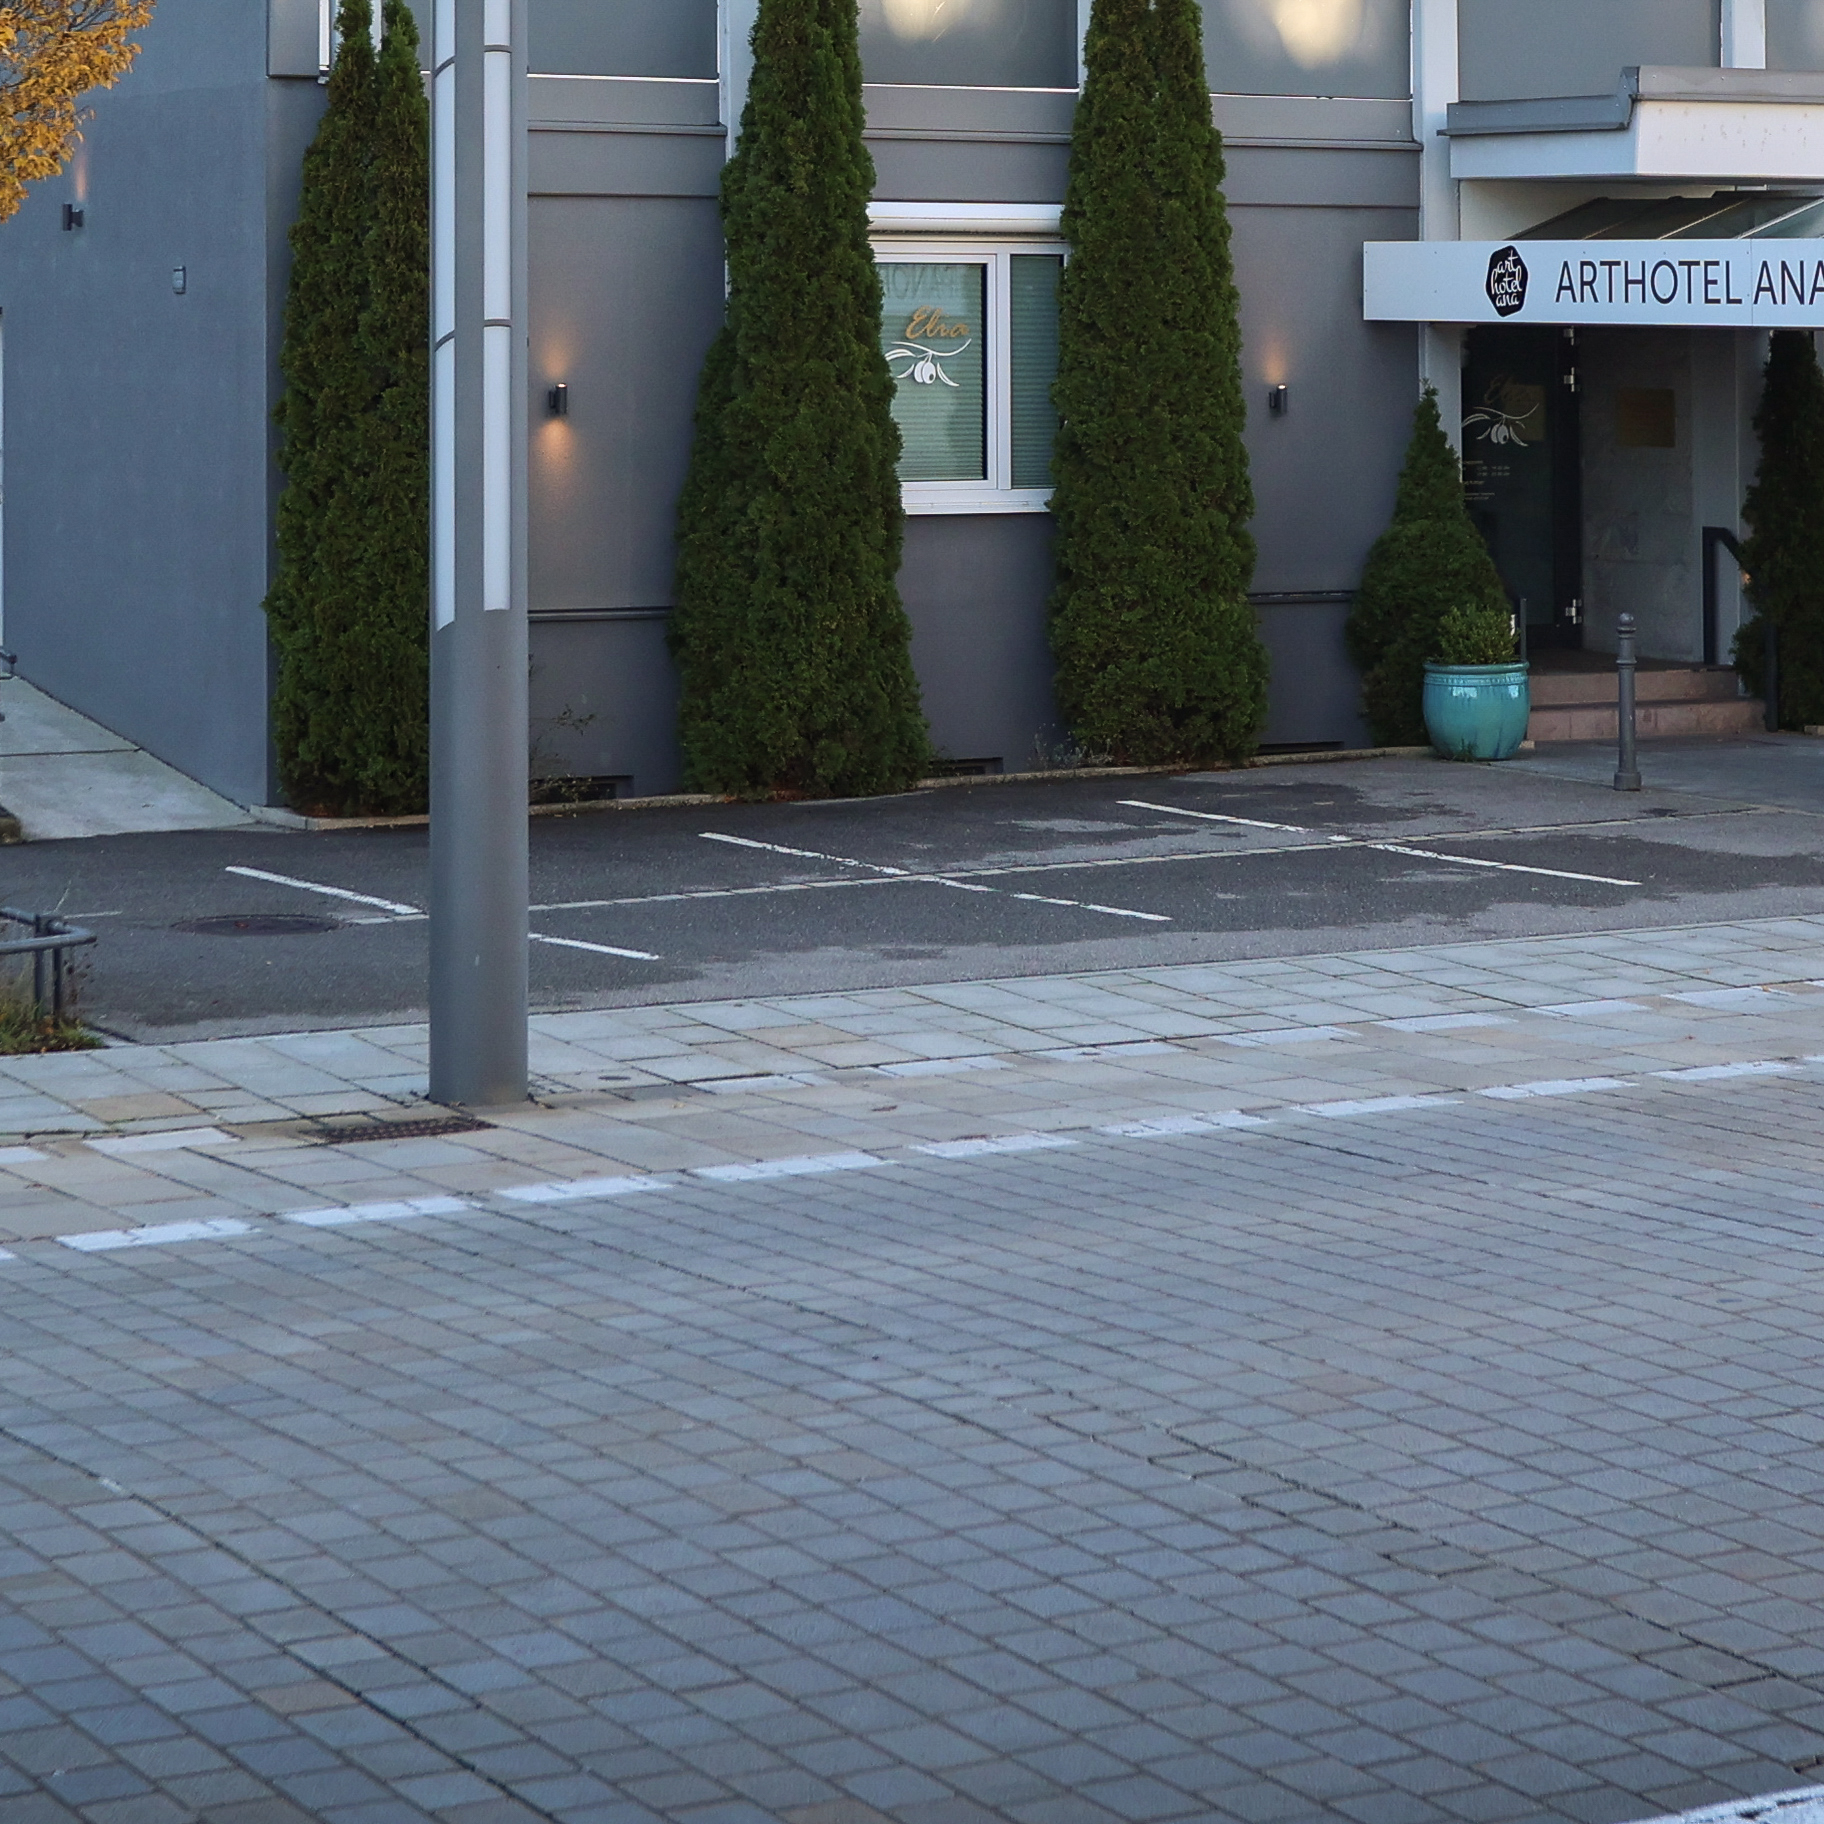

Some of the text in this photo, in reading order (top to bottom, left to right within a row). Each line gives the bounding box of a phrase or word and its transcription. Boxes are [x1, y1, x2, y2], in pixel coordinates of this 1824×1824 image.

[1497, 249, 1518, 274] art
[1491, 265, 1523, 295] hotel
[1554, 259, 1743, 305] ARTHOTEL
[1496, 293, 1520, 307] ana
